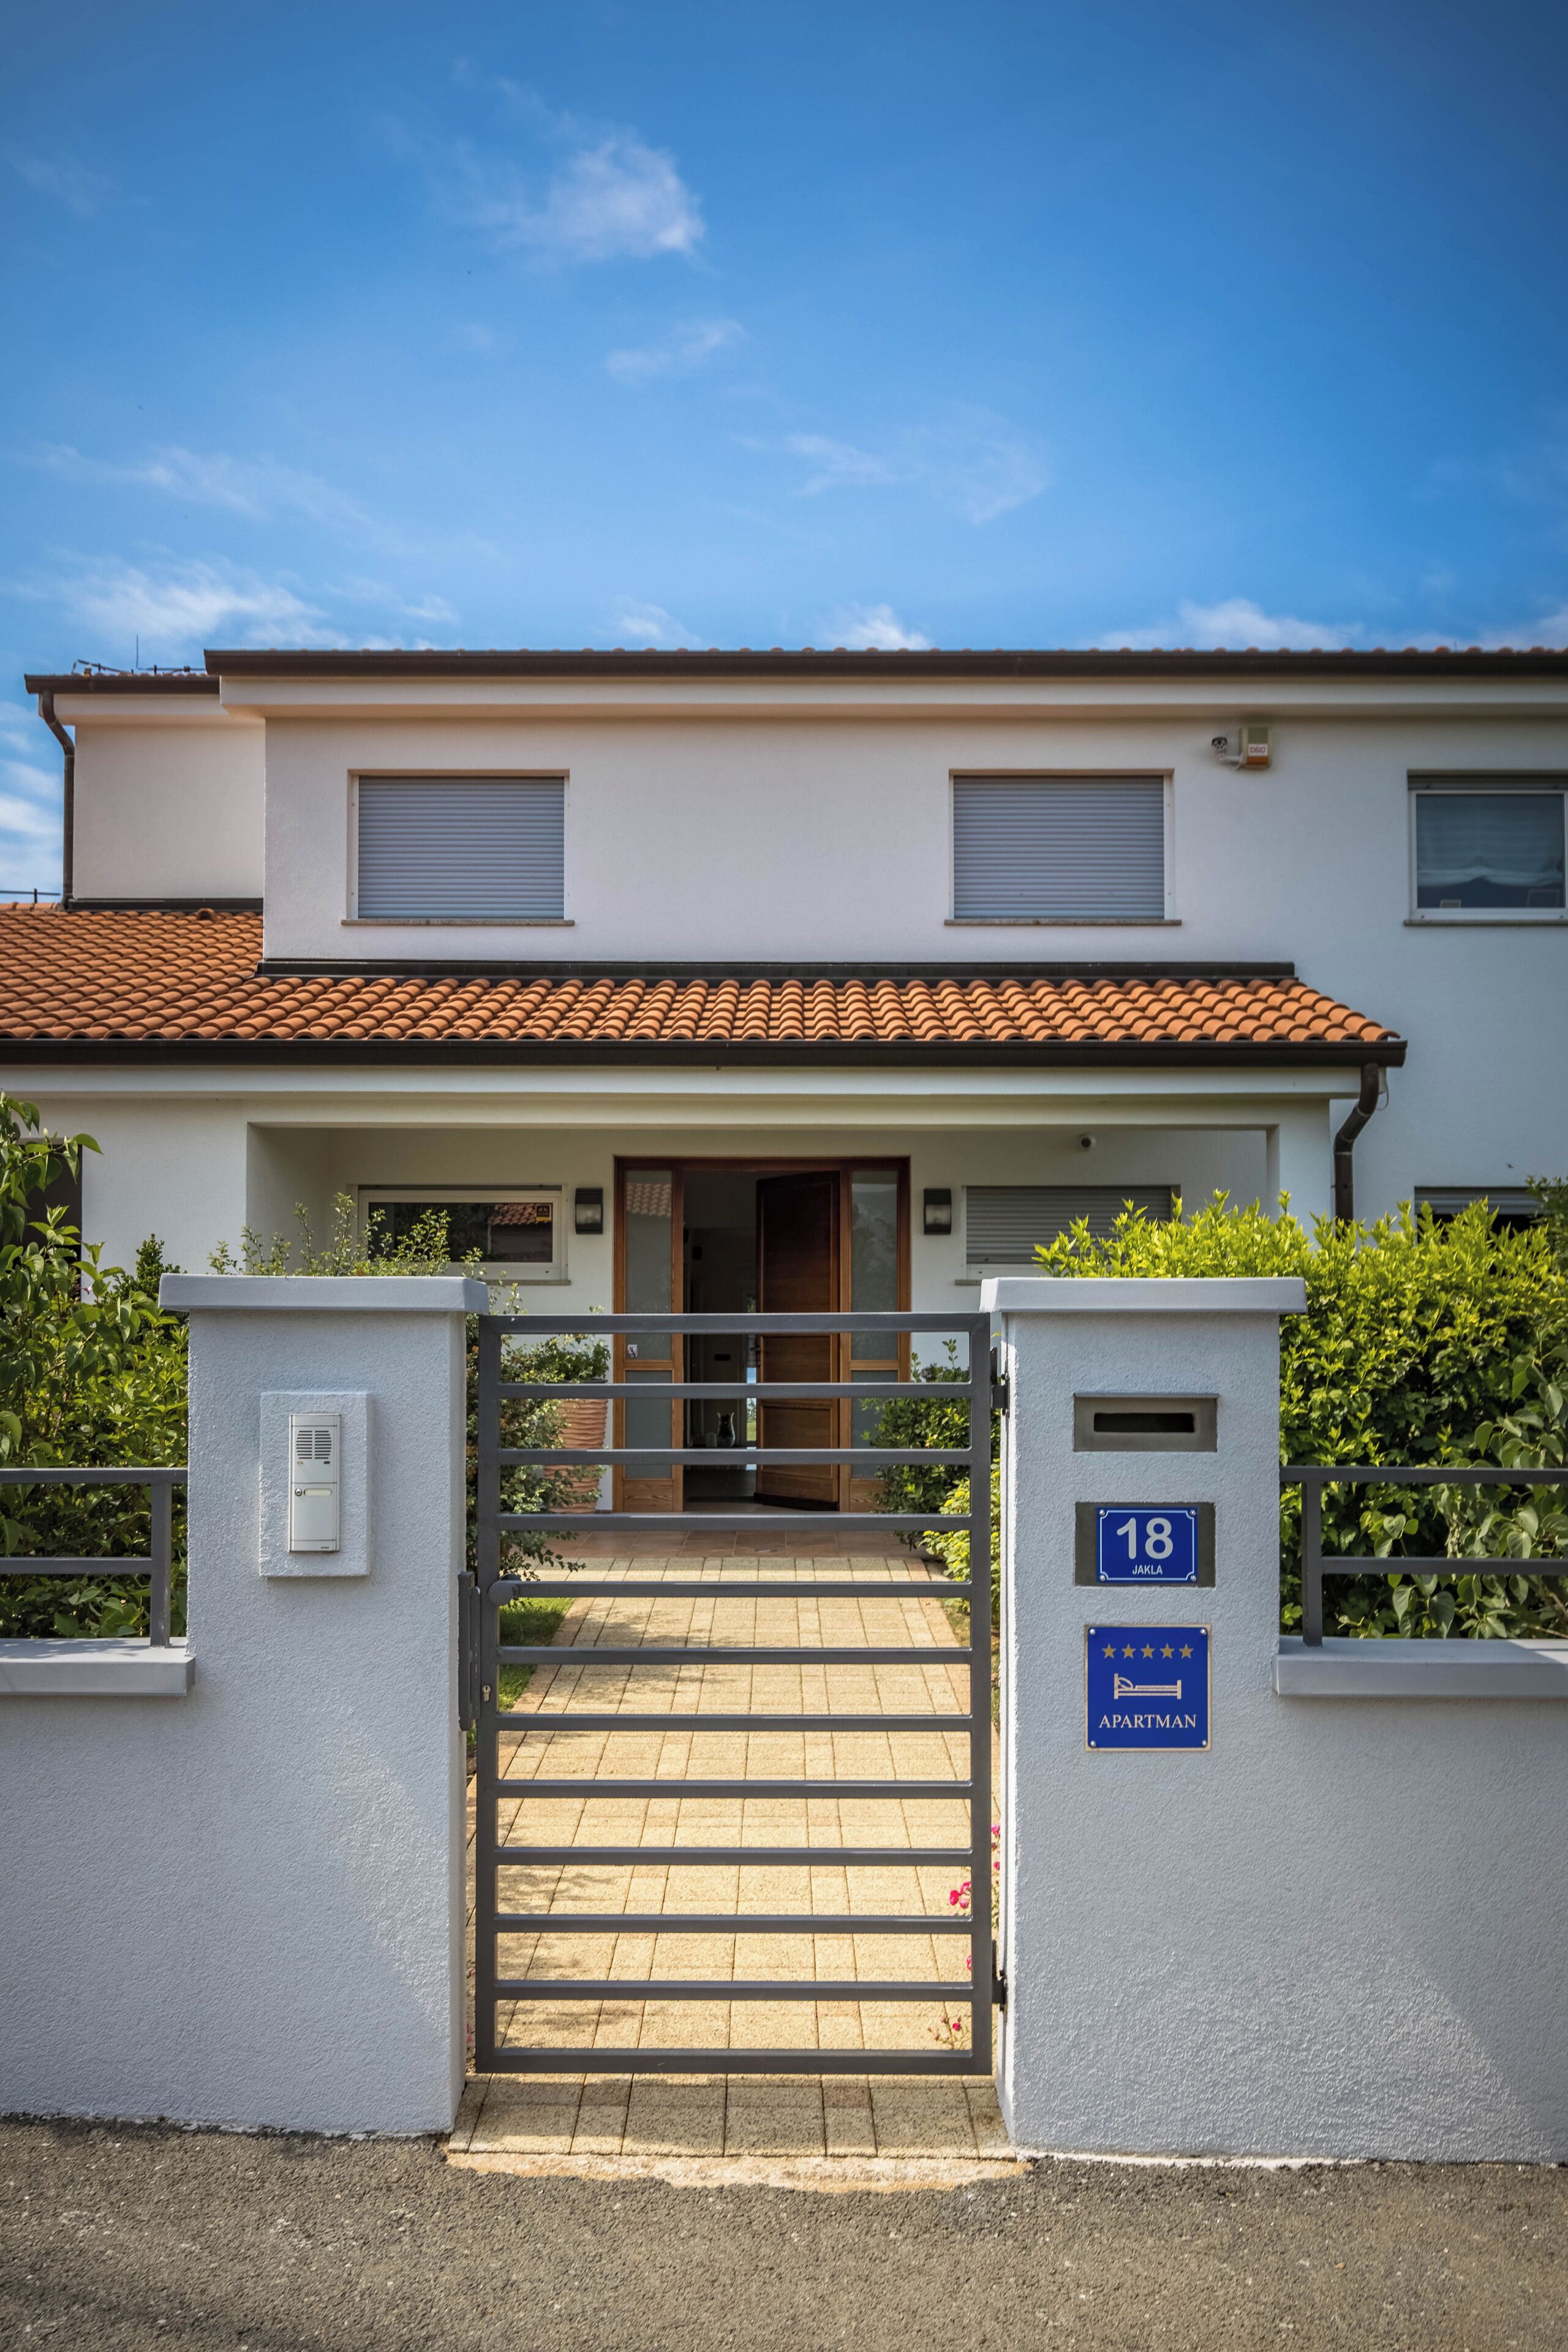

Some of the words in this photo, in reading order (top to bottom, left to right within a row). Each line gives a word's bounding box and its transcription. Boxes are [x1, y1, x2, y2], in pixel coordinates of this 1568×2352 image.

[1117, 1517, 1174, 1559] 18
[1132, 1564, 1163, 1575] JAKLA
[1098, 1714, 1196, 1728] APARTMAN
